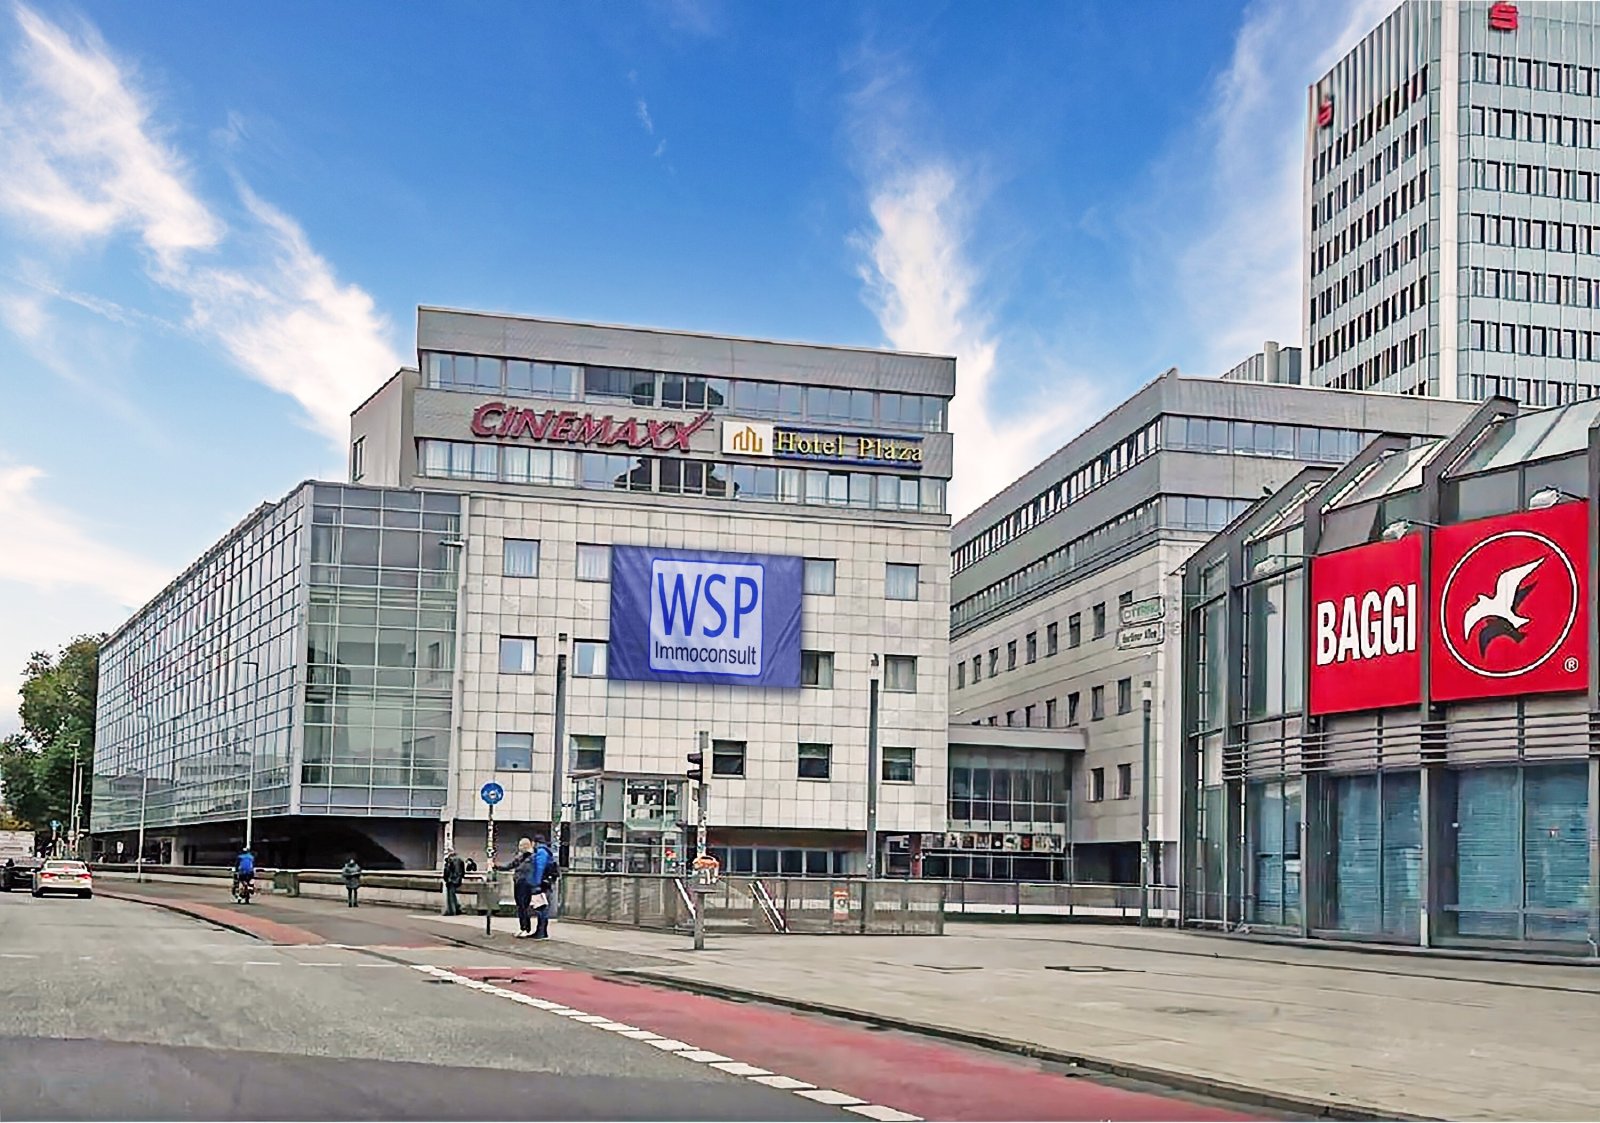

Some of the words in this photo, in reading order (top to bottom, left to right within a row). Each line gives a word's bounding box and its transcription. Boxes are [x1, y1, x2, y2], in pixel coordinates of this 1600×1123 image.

[470, 402, 712, 452] CINEMAXX
[777, 431, 844, 456] Hotel
[859, 439, 923, 462] Plaza
[658, 572, 758, 639] WSP
[1316, 583, 1417, 666] BAGGI
[655, 641, 757, 666] Immoconsult
